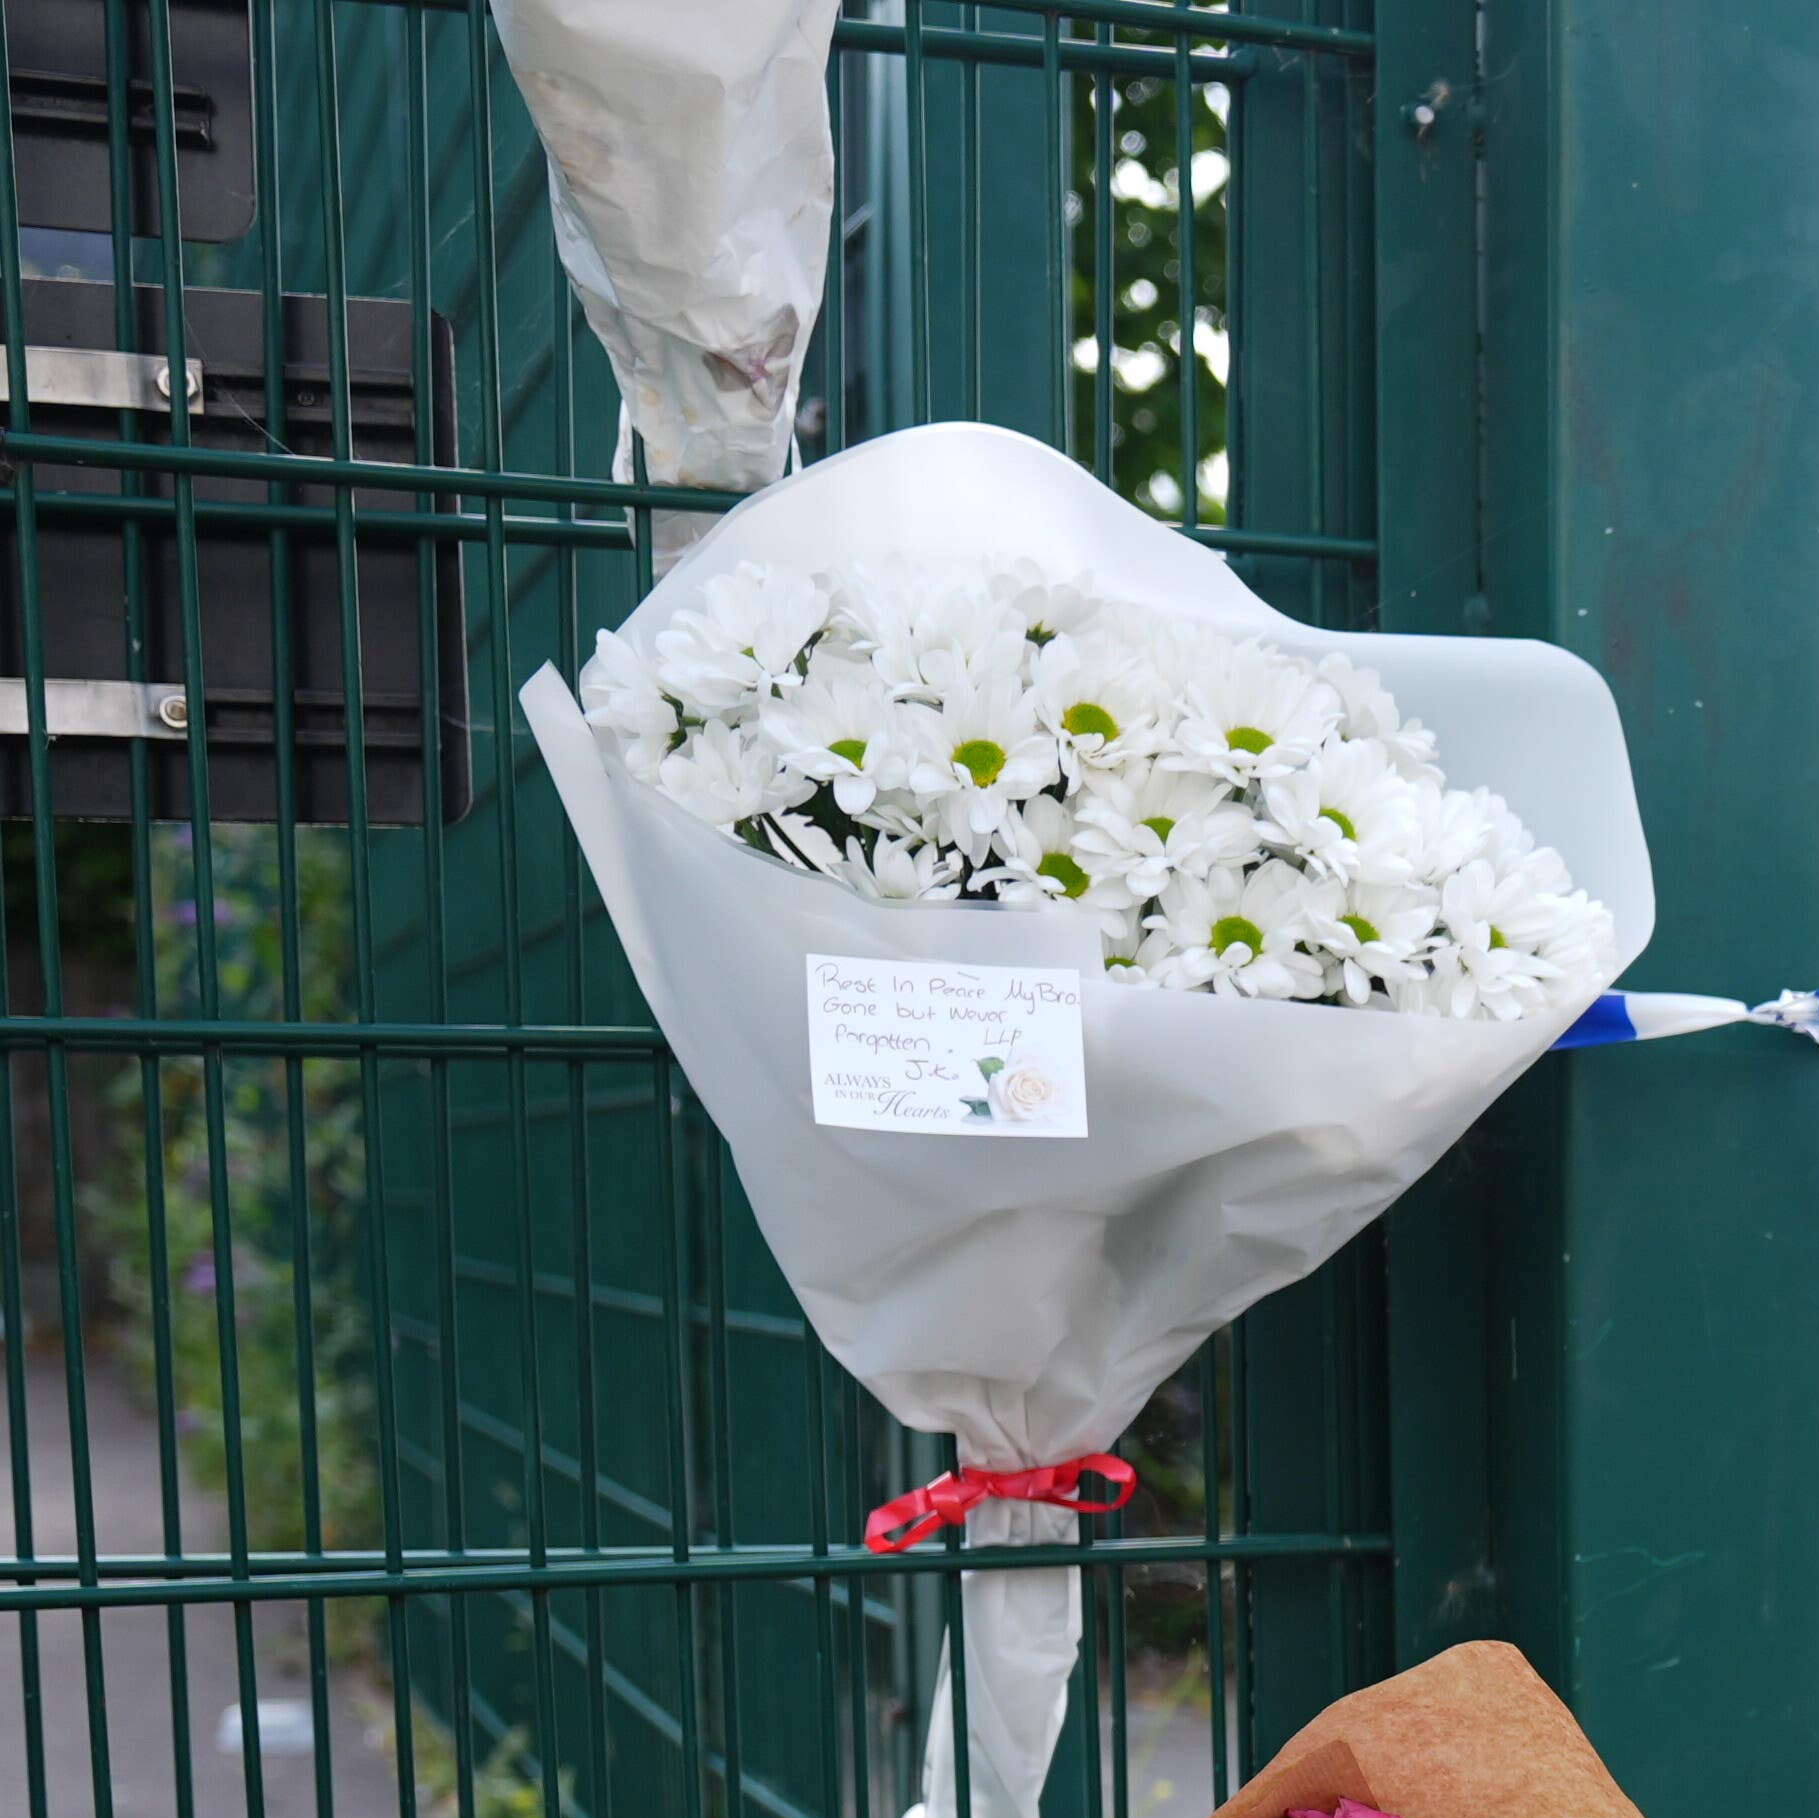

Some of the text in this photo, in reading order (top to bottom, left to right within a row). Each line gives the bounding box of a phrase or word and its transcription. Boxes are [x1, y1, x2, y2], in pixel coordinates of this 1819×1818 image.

[815, 963, 876, 993] Rest
[893, 976, 914, 992] In
[929, 978, 986, 999] Peace
[1005, 979, 1035, 1015] My
[823, 996, 876, 1016] Gone
[896, 1002, 936, 1020] but
[824, 1073, 891, 1088] ALWAYS
[835, 1090, 950, 1119] IN OUR Hearts
